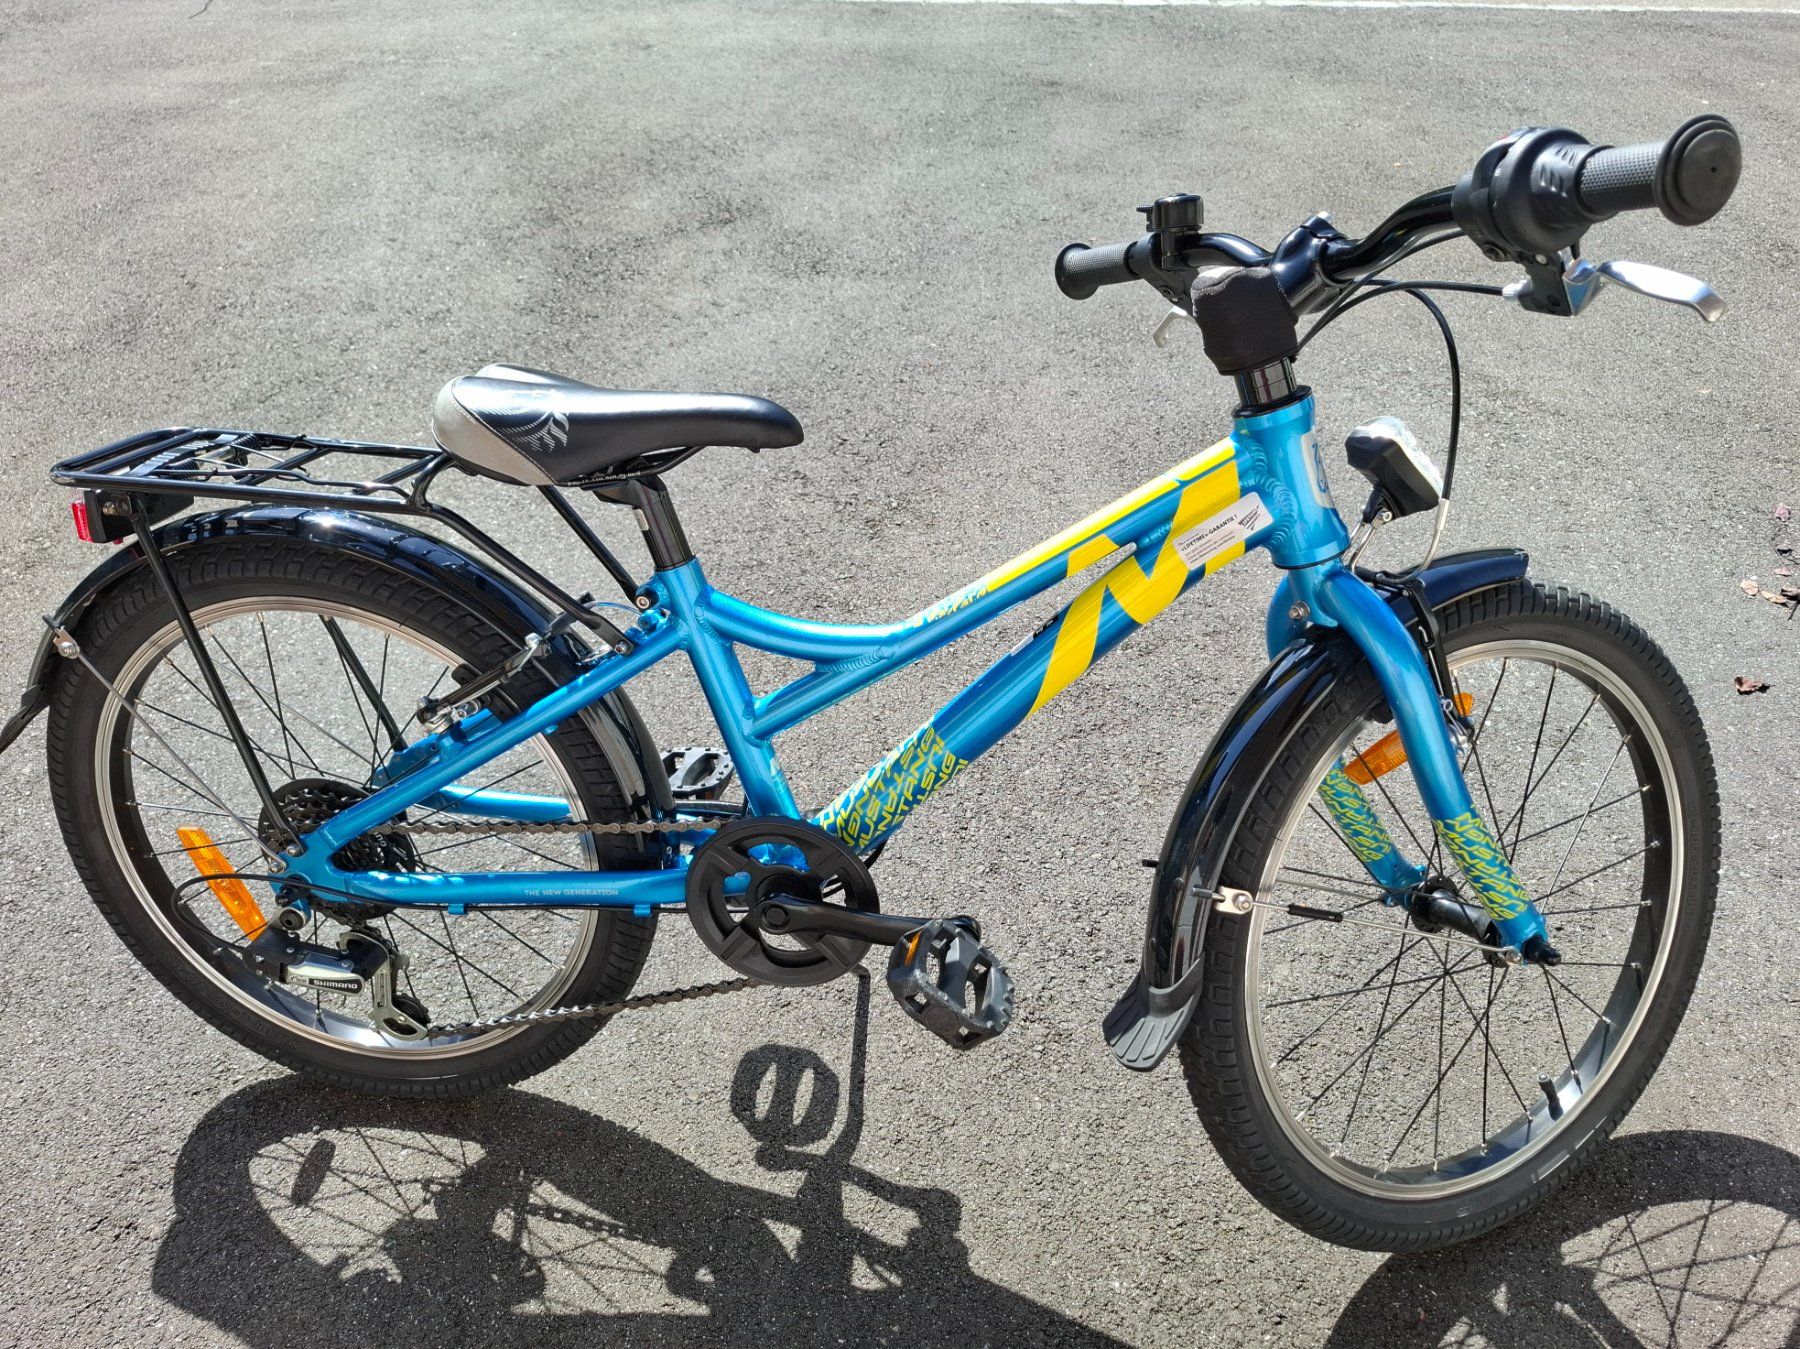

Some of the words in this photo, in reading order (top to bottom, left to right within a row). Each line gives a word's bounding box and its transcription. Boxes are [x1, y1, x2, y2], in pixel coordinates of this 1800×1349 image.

[524, 889, 540, 897] THE
[563, 888, 619, 896] GENERATION
[312, 979, 358, 990] SHIMANO
